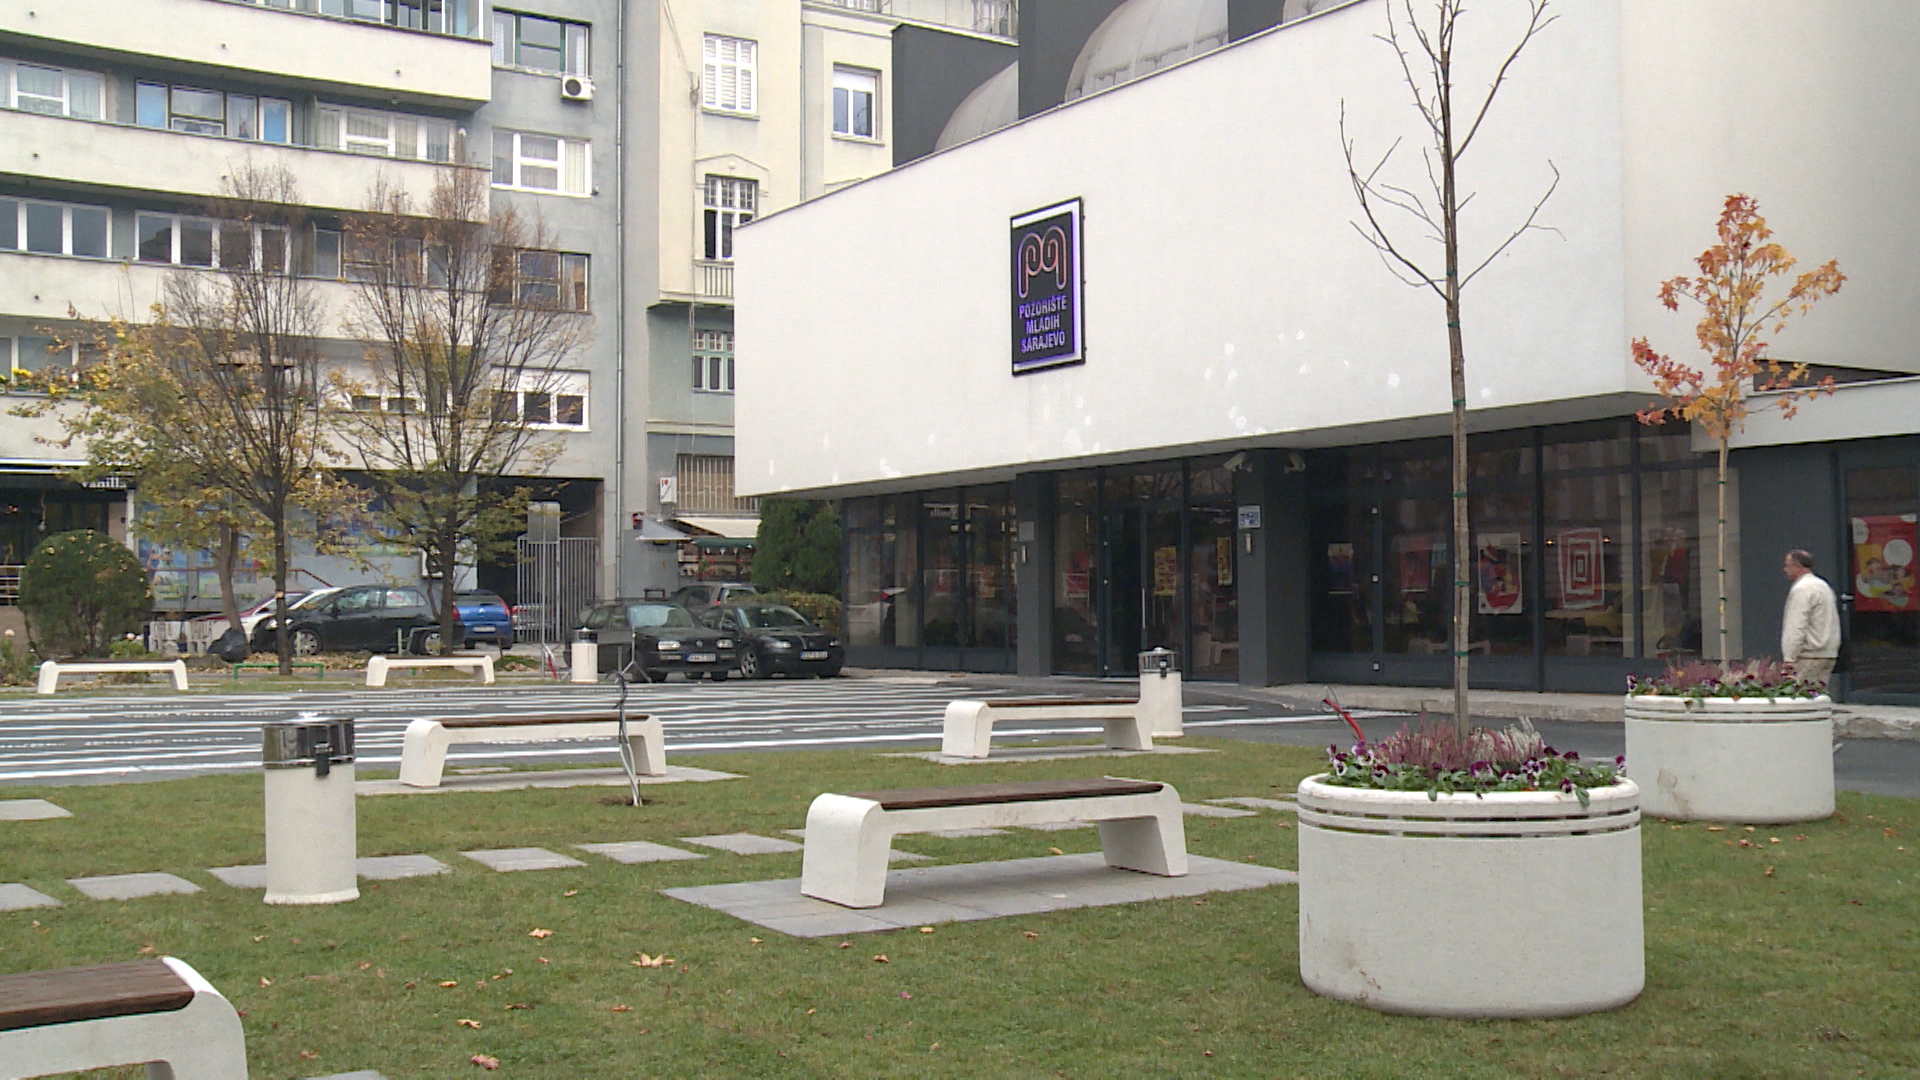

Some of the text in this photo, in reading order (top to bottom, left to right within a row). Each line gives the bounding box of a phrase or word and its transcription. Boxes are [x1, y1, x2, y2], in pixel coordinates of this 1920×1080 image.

[1018, 294, 1067, 320] POZORIŠTE
[1025, 313, 1060, 335] MLADIH
[1021, 330, 1066, 353] SARAJEVO
[82, 477, 127, 488] vanilla
